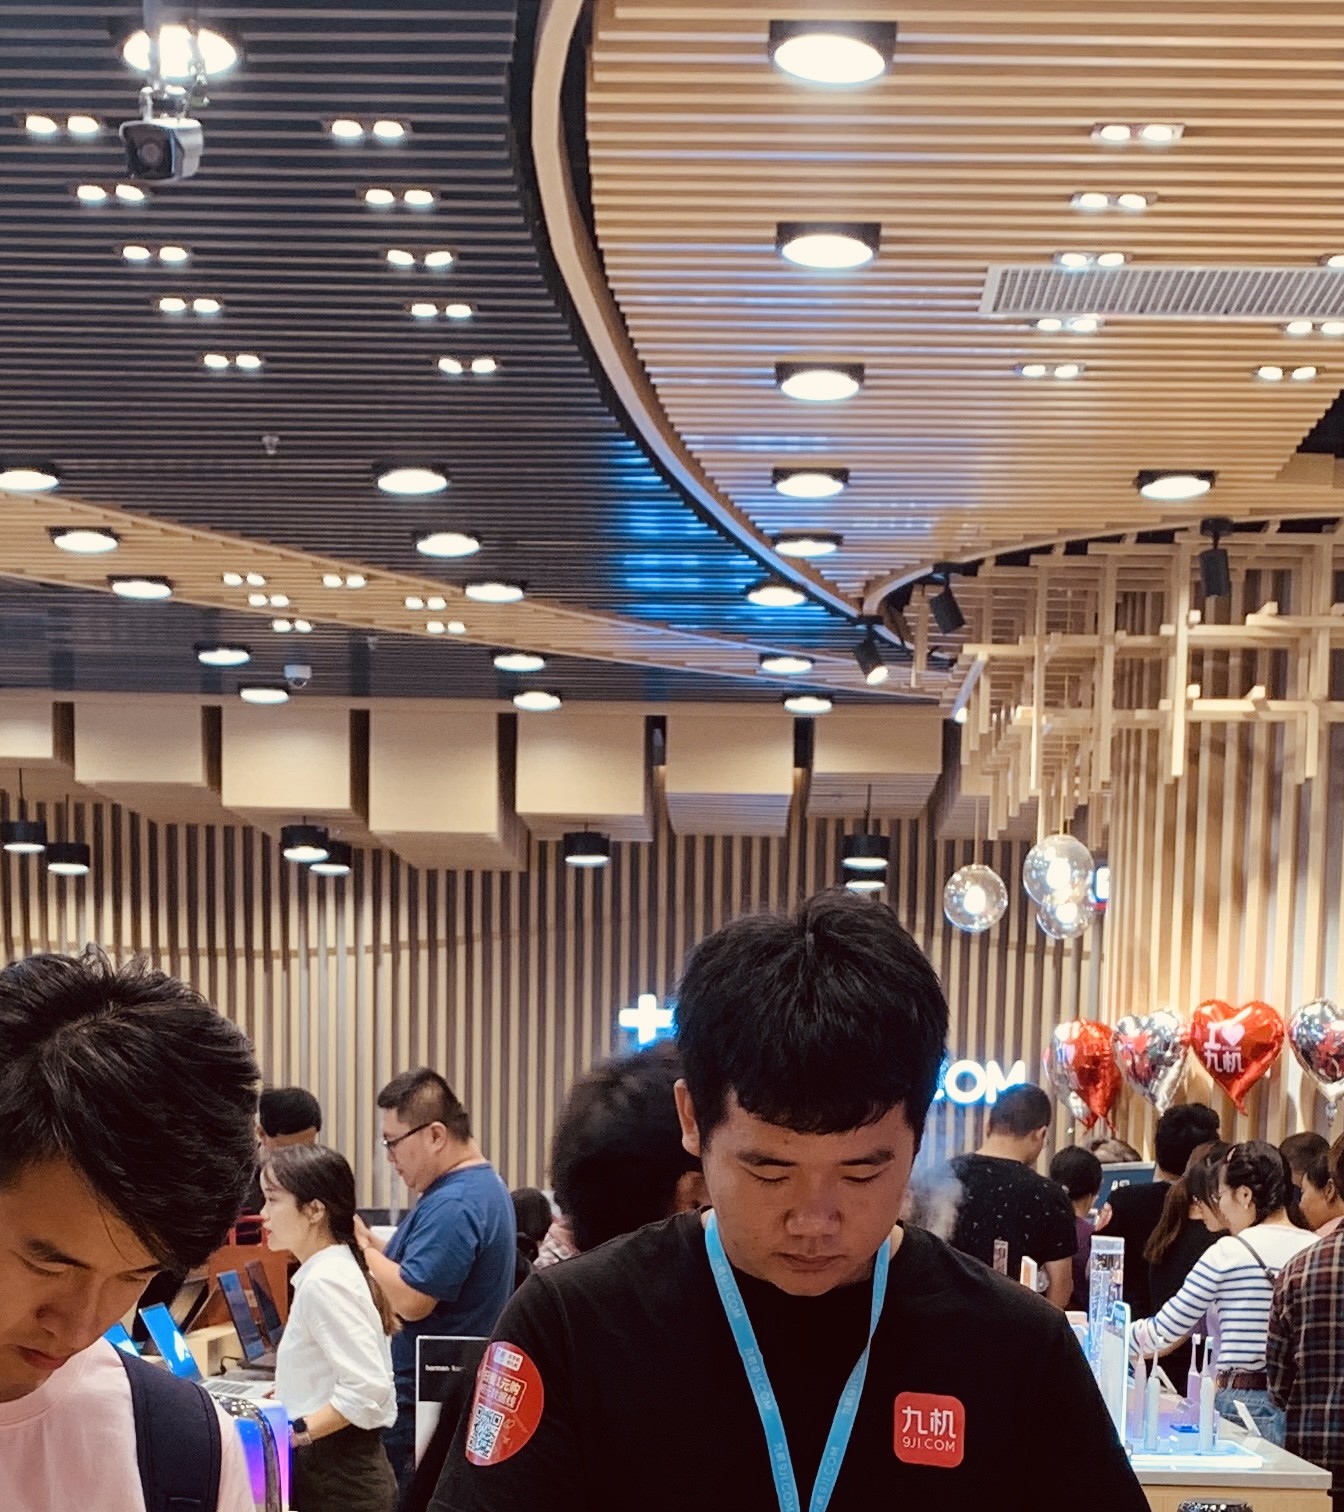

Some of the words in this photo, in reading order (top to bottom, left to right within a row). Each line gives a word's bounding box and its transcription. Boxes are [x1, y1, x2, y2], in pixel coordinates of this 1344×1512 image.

[1204, 1051, 1244, 1074] 九机
[936, 1060, 1026, 1104] OM
[901, 1405, 956, 1439] 九机
[902, 1436, 956, 1453] 9JI.COM
